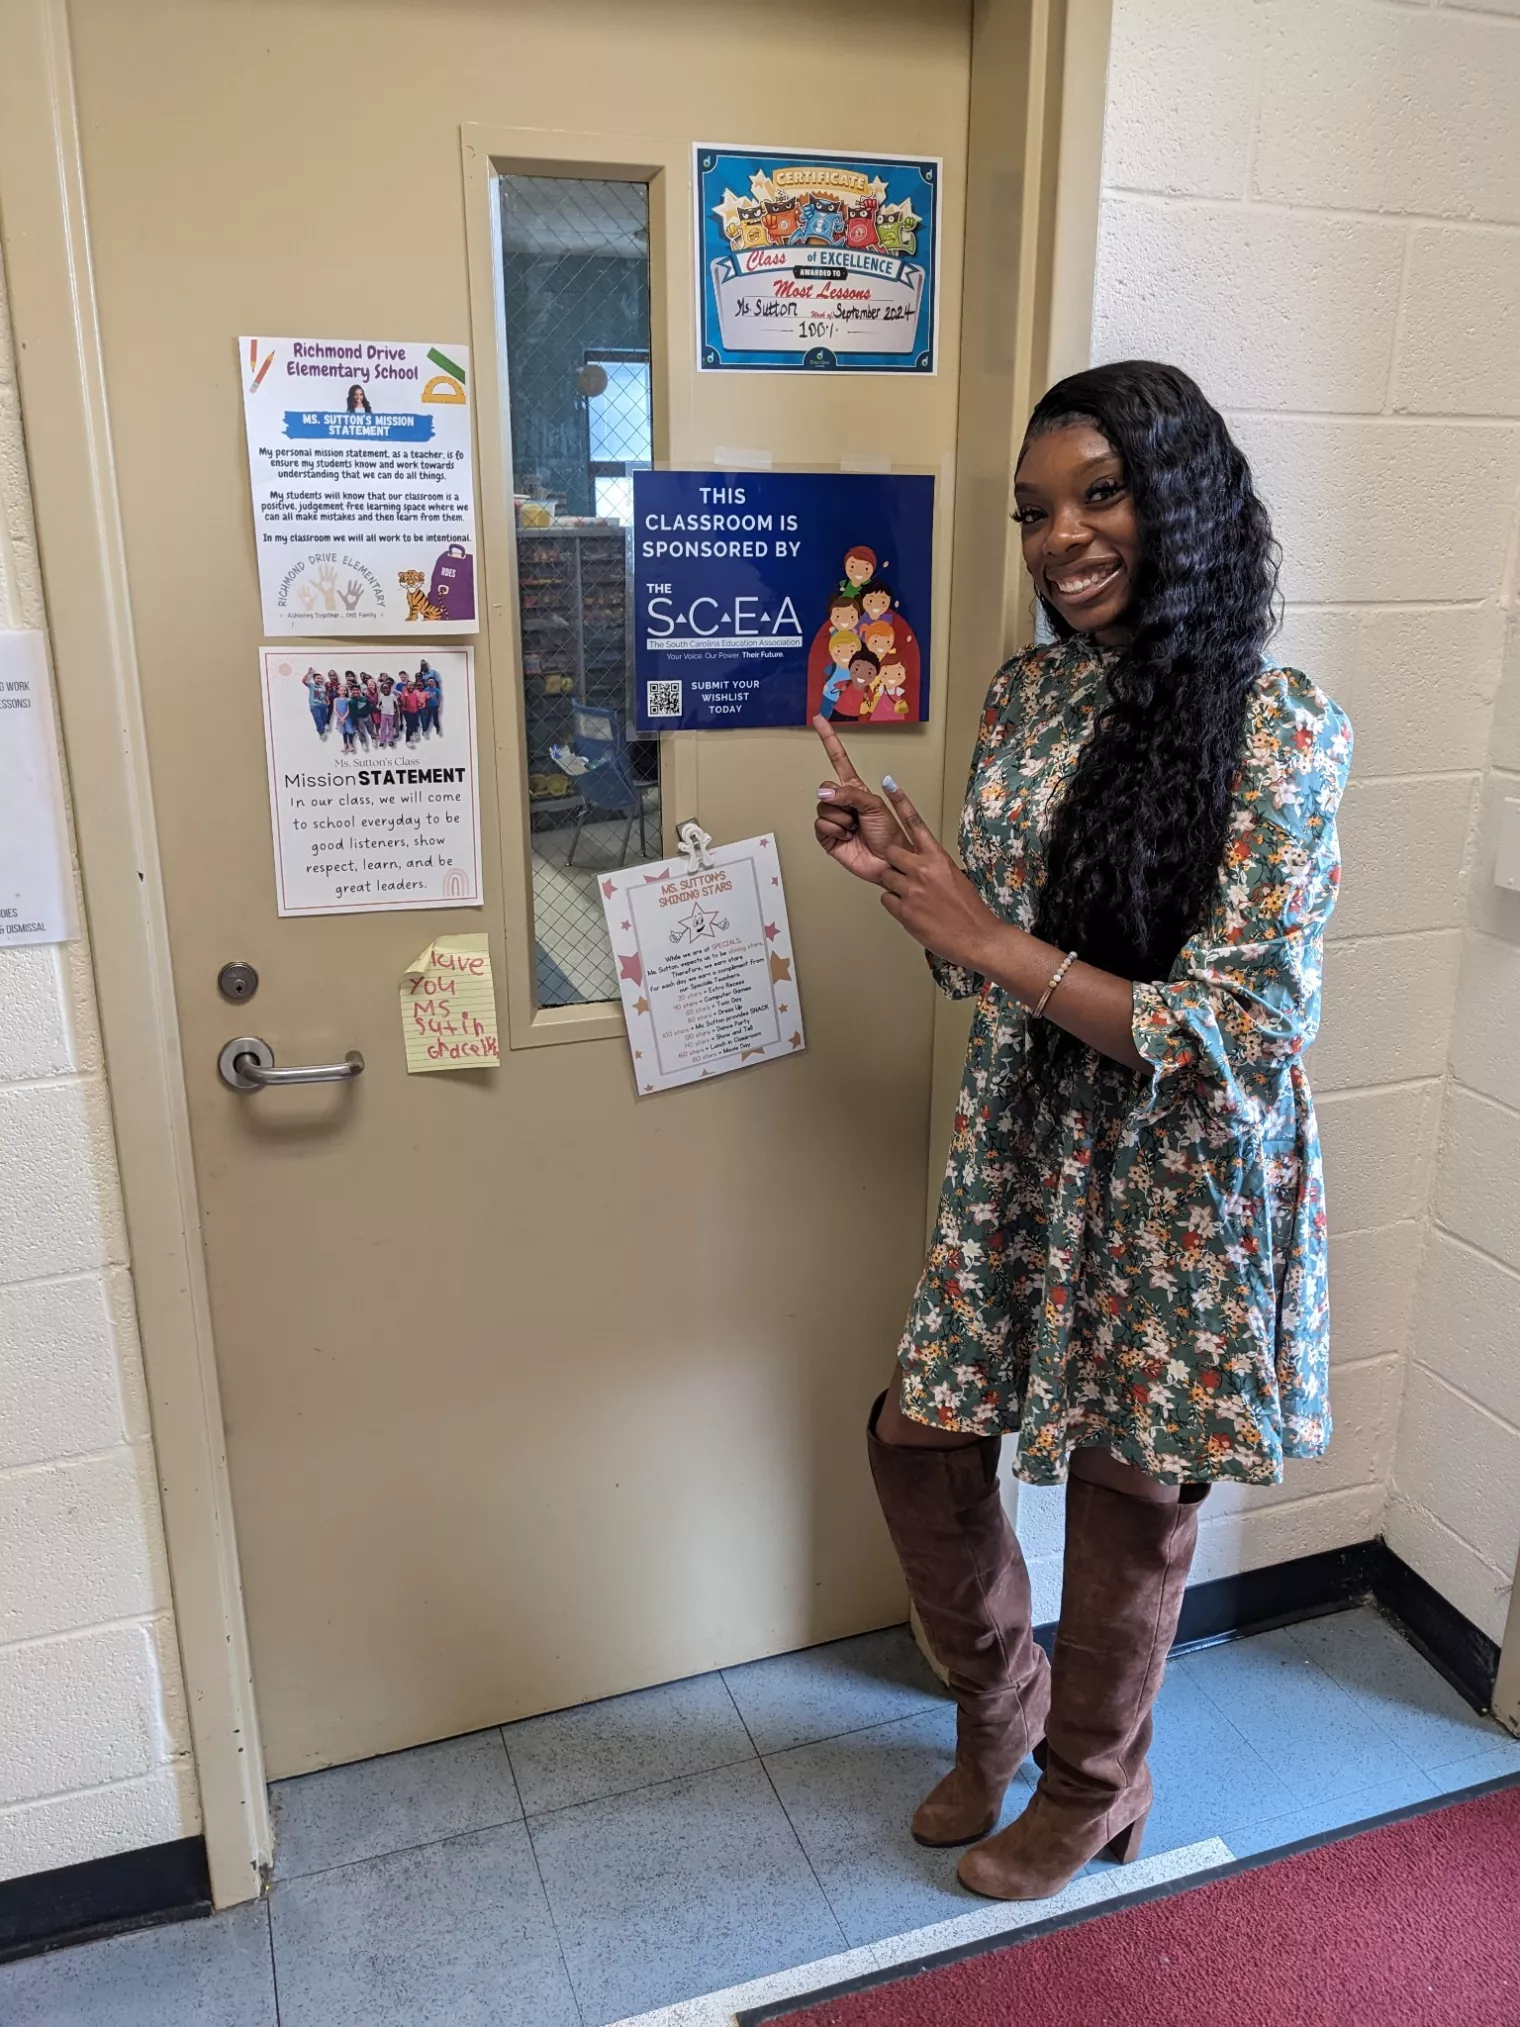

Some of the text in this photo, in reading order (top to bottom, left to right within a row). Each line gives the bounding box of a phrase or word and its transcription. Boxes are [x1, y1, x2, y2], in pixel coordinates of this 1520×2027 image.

[776, 170, 866, 190] CERTIFICATE
[746, 250, 893, 274] Class of EXCELLENCE
[800, 269, 831, 277] AWARDED
[773, 280, 871, 300] Most Lessons
[754, 300, 798, 317] Sutton
[834, 302, 915, 322] September 2024
[294, 342, 406, 361] Richmond Drive
[287, 361, 418, 383] Elementary School
[303, 414, 414, 426] MS. SUTTON'S MISSION
[329, 426, 389, 436] STATEMENT
[259, 447, 273, 458] My
[275, 448, 312, 458] personal
[314, 449, 344, 457] mission
[346, 449, 390, 458] statement,
[410, 450, 445, 459] teacher,
[301, 460, 314, 470] my
[316, 460, 352, 468] students
[379, 460, 394, 468] and
[278, 470, 339, 481] understanding
[342, 470, 360, 479] that
[394, 471, 404, 479] do
[419, 472, 446, 483] things.
[270, 491, 284, 502] My
[286, 491, 322, 499] students
[324, 491, 341, 500] will
[343, 492, 365, 500] know
[368, 492, 386, 500] that
[699, 488, 746, 504] THIS
[298, 502, 344, 513] judgement
[346, 502, 364, 510] free
[367, 503, 401, 513] learning
[404, 504, 426, 513] space
[358, 513, 373, 521] and
[375, 513, 394, 521] then
[397, 512, 418, 521] learn
[420, 513, 440, 521] from
[442, 513, 464, 522] them.
[645, 514, 798, 531] CLASSROOM IS
[263, 533, 272, 542] In
[275, 535, 287, 544] my
[290, 534, 330, 542] classroom
[379, 534, 400, 542] work
[414, 534, 424, 542] be
[426, 534, 471, 542] intentional.
[642, 541, 801, 557] SPONSORED BY
[441, 567, 456, 578] RDES
[278, 553, 386, 608] RICHMOND DRIVE ELEMENTARY
[646, 584, 672, 594] THE
[666, 640, 688, 648] South
[689, 639, 720, 648] Carolina
[721, 638, 757, 647] Education
[6, 681, 31, 691] WORK
[691, 681, 759, 690] SUBMIT YOUR
[701, 692, 749, 701] WISHLIST
[710, 705, 742, 714] TODAY
[334, 757, 420, 768] Ms. Sutton's Class
[285, 768, 466, 788] Mission STATEMENT
[290, 791, 461, 807] In our class, we will come
[293, 811, 460, 831] to school everyday to be
[312, 834, 445, 856] good listeners, show
[306, 854, 453, 877] respect, learn, and be
[336, 879, 427, 898] great leaders.
[661, 870, 726, 895] MS. SUTTON'S
[659, 881, 732, 908] SHINING STARS
[6, 922, 47, 933] DISMISSAL
[665, 954, 681, 962] While
[708, 980, 744, 993] Extra Recess
[750, 1004, 769, 1014] SNACK
